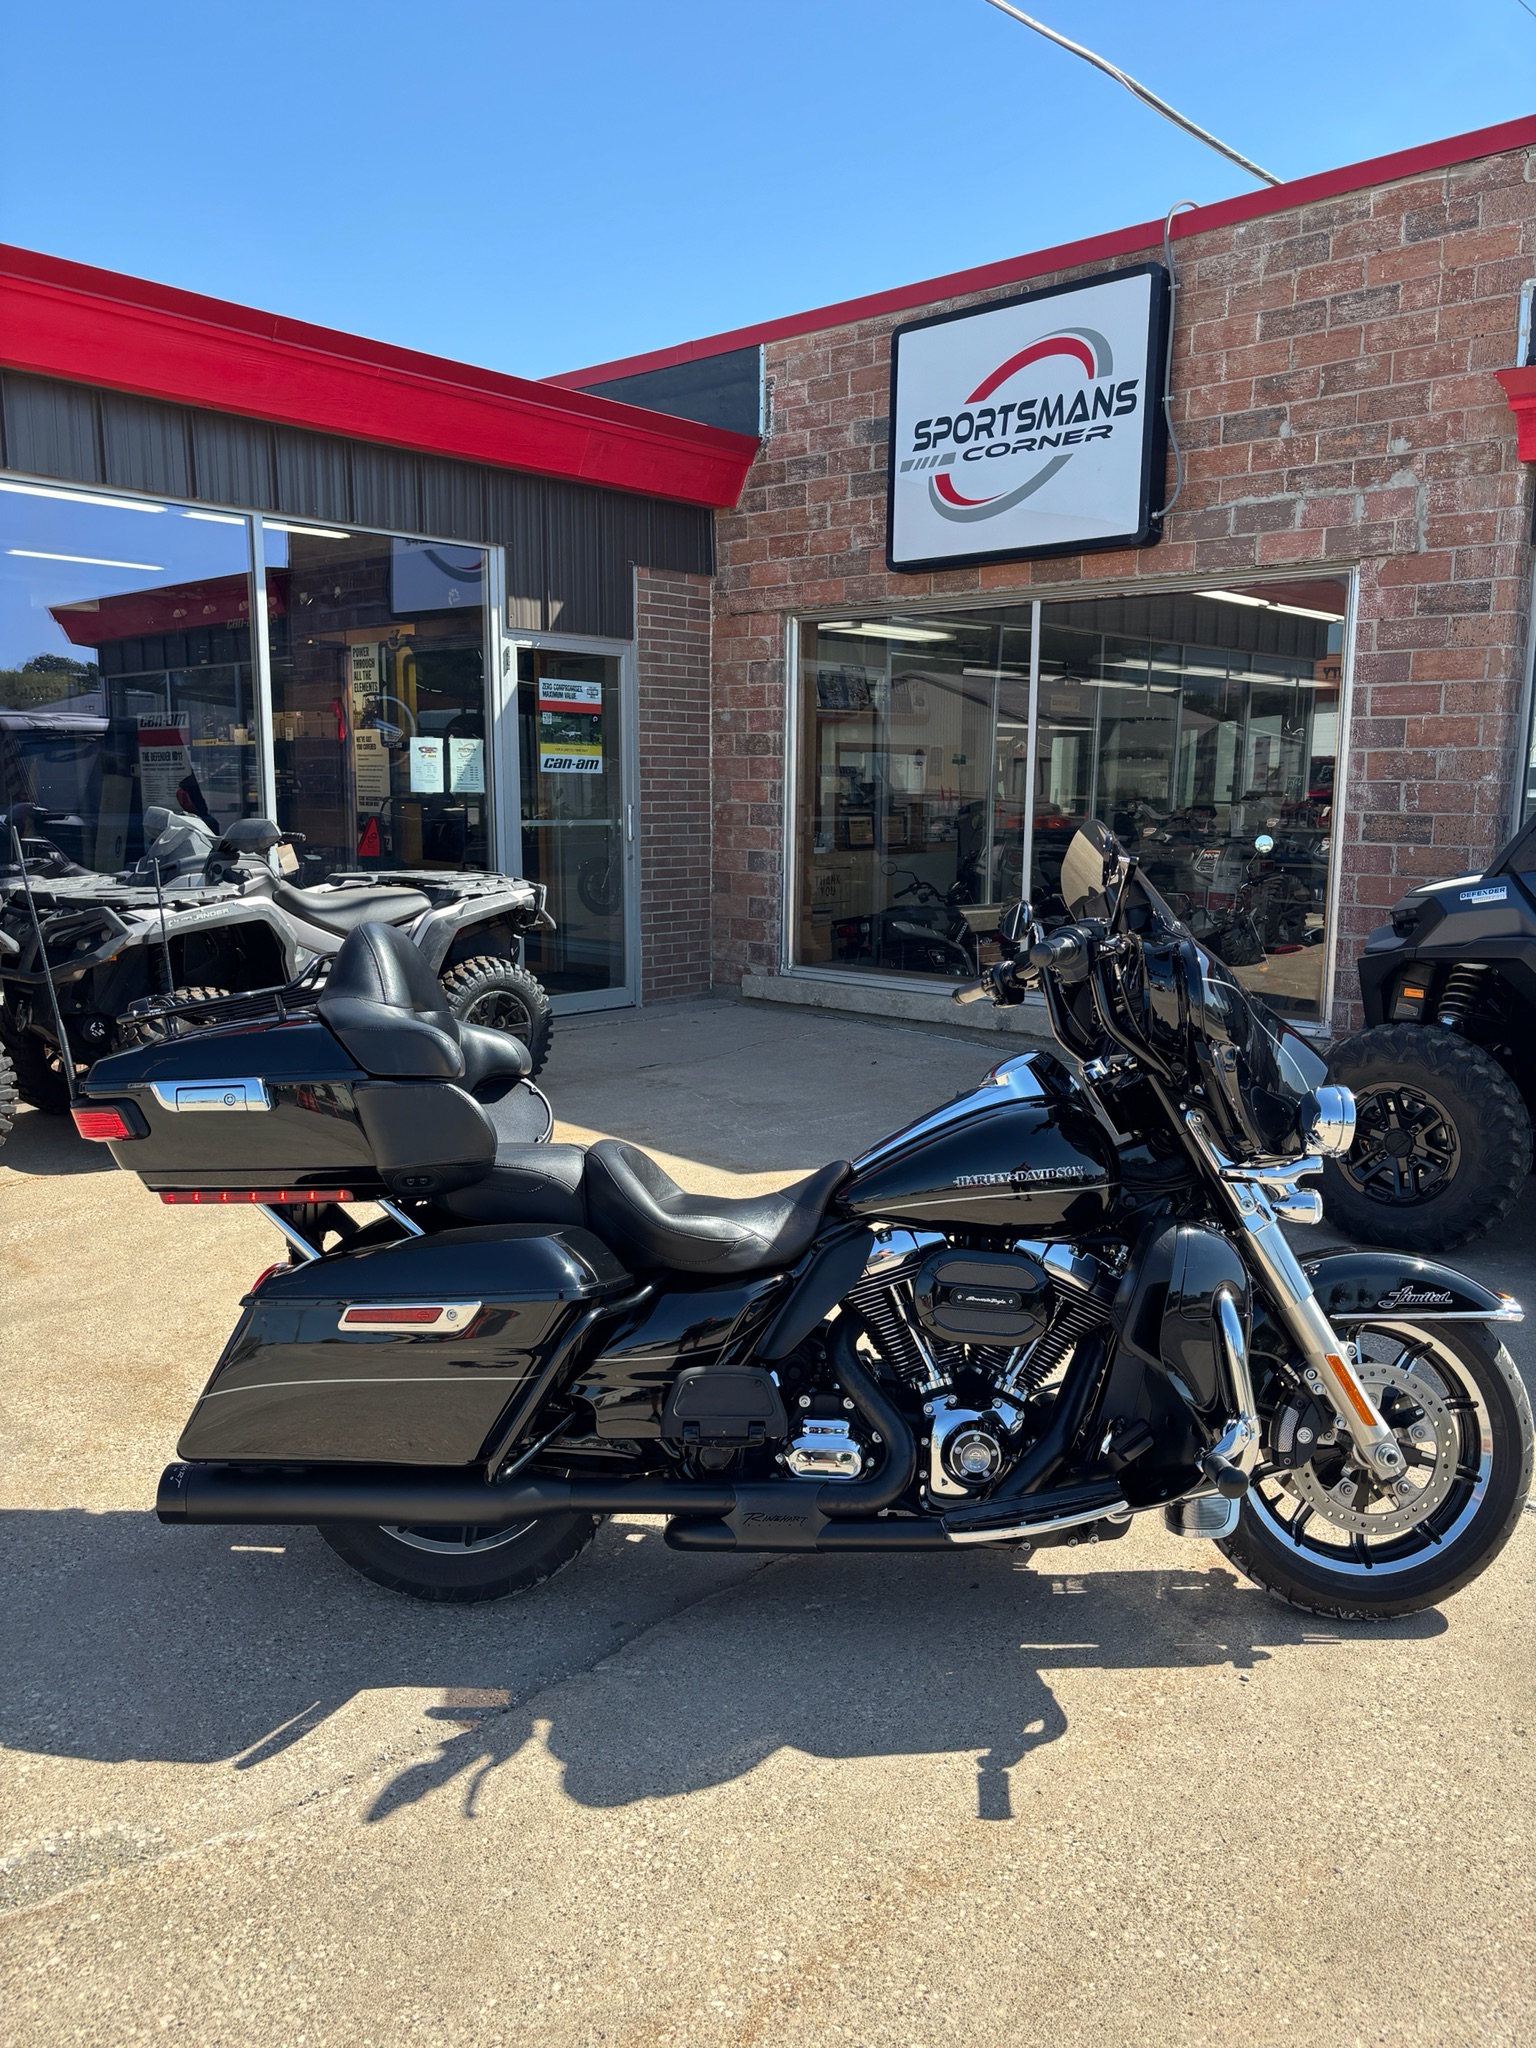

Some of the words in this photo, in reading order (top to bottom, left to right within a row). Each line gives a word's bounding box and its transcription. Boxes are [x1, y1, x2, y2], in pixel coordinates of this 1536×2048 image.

[912, 379, 1139, 452] SPORTSMANS
[962, 424, 1114, 462] CORNER
[352, 646, 370, 658] POWER
[353, 658, 375, 670] THROUGH
[353, 670, 362, 681] ALL
[363, 670, 372, 681] THE
[354, 681, 379, 693] ELEMENTS
[542, 682, 553, 690] ZERO
[542, 690, 564, 699] MAXIMUM
[139, 713, 187, 728] can-am
[543, 757, 600, 770] can-am
[814, 874, 841, 886] THANK
[820, 885, 836, 897] YOU
[1460, 887, 1506, 899] DEFENDER
[955, 921, 969, 944] HONDA
[1378, 1285, 1454, 1310] Limited
